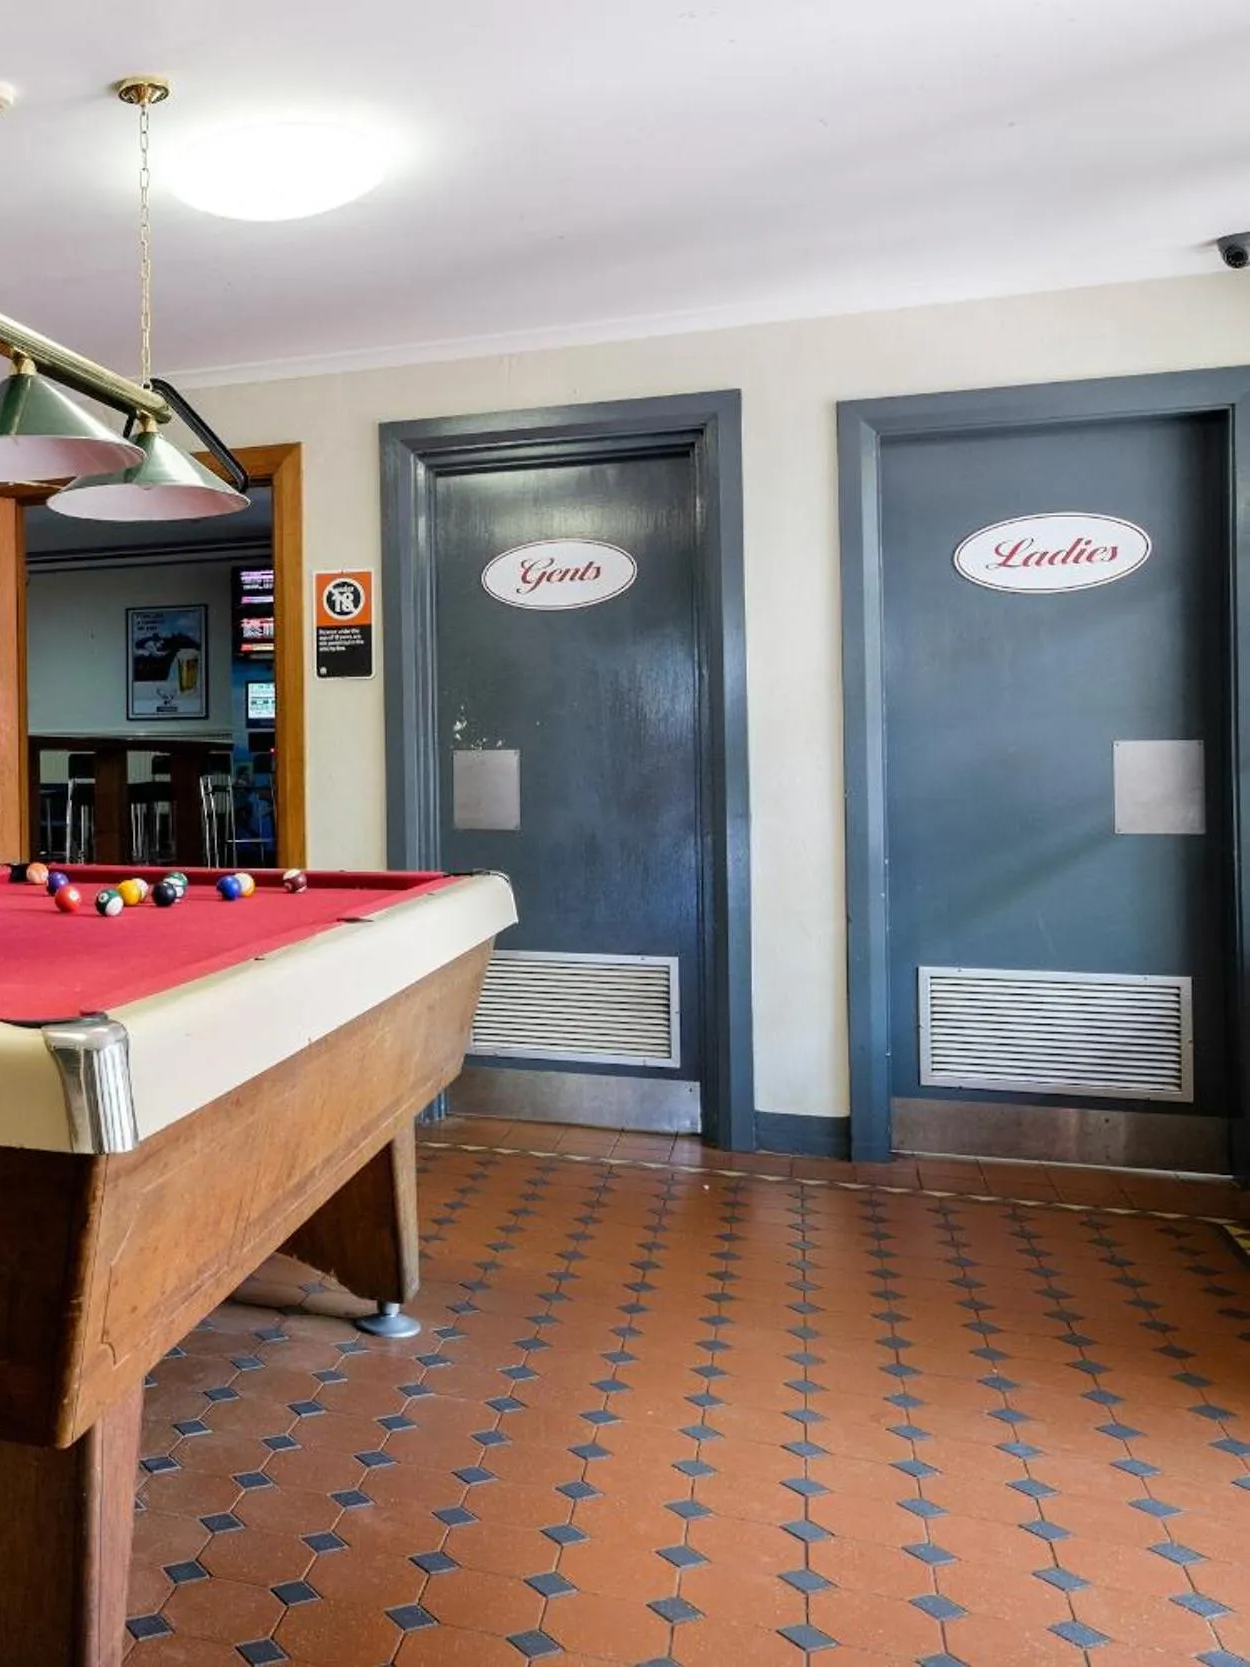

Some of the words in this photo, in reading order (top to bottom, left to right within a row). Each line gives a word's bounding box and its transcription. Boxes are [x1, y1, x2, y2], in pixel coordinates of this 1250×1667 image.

[986, 537, 1119, 571] Ladies
[516, 557, 602, 594] Gents
[332, 592, 355, 613] 18
